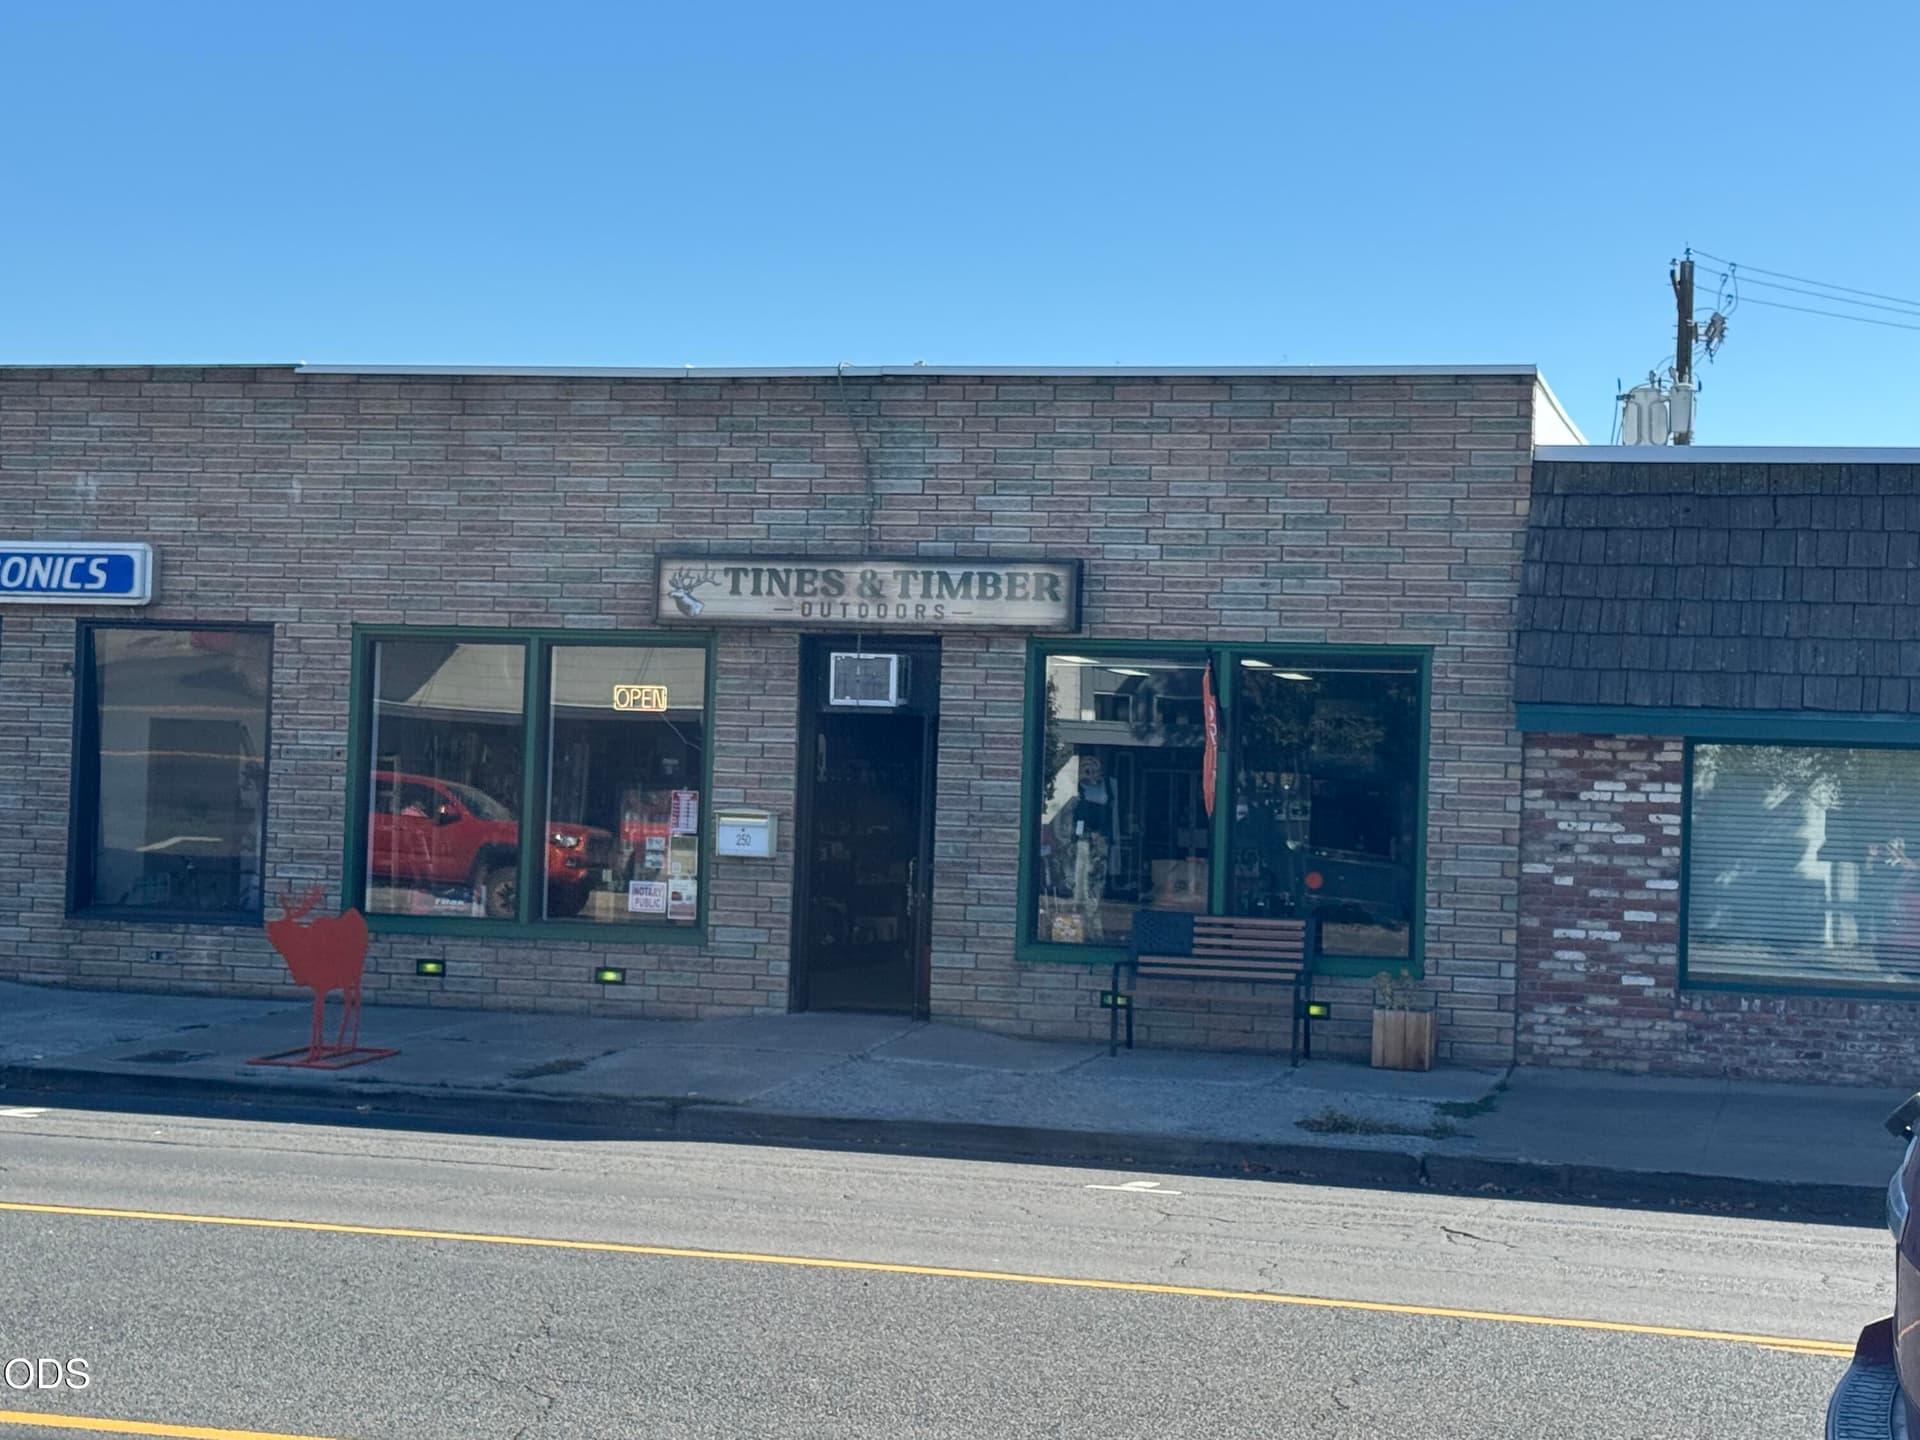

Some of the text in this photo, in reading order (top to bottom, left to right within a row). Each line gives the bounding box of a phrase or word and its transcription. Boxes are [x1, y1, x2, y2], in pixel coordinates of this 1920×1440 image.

[0, 556, 109, 590] ONICS
[723, 567, 1062, 602] TINES & TIMBER
[801, 601, 945, 619] OUTDOORS
[616, 688, 665, 708] OPEN
[736, 833, 752, 847] 250
[632, 886, 663, 897] NOTARY
[634, 897, 661, 908] PUBLIC
